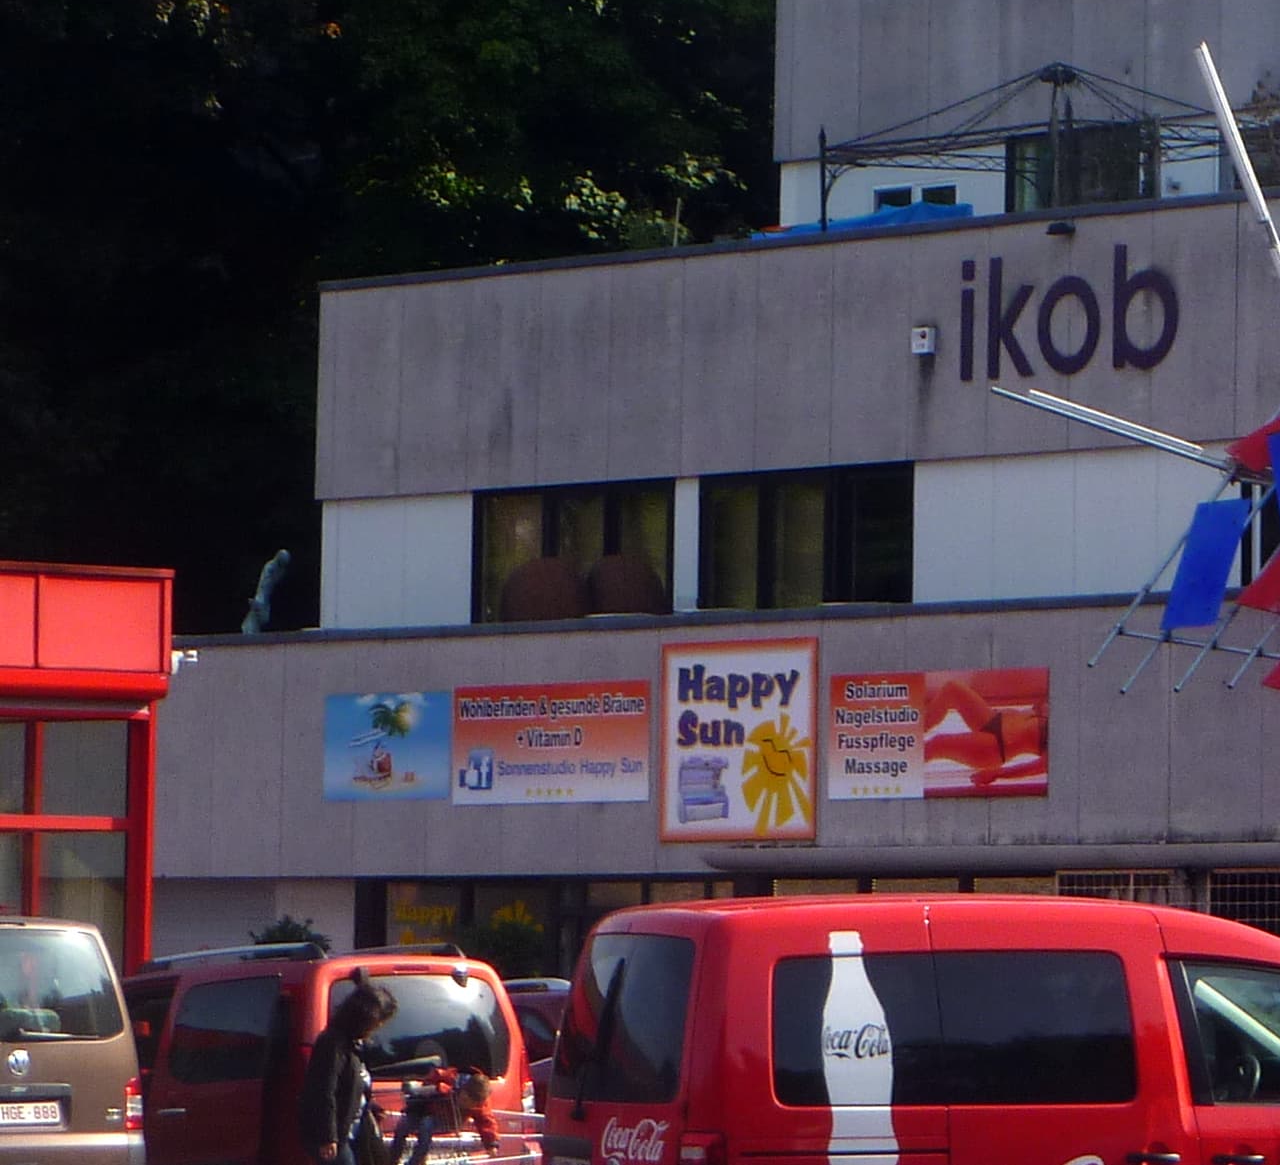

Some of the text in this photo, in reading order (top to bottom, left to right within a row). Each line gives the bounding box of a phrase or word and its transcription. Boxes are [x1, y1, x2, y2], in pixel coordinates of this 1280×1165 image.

[960, 243, 1178, 382] ikob
[677, 663, 799, 709] Happy
[846, 681, 908, 700] Solarium
[459, 693, 645, 719] Wohlbefinden & gesunde Bräune
[836, 706, 919, 728] Nagelstudio
[526, 727, 571, 748] Vitamin
[573, 727, 583, 747] D
[677, 709, 745, 747] Sun
[837, 733, 915, 753] Fusspflege
[498, 756, 644, 779] Sonnenstudio Happy Sun
[844, 757, 908, 778] Massage
